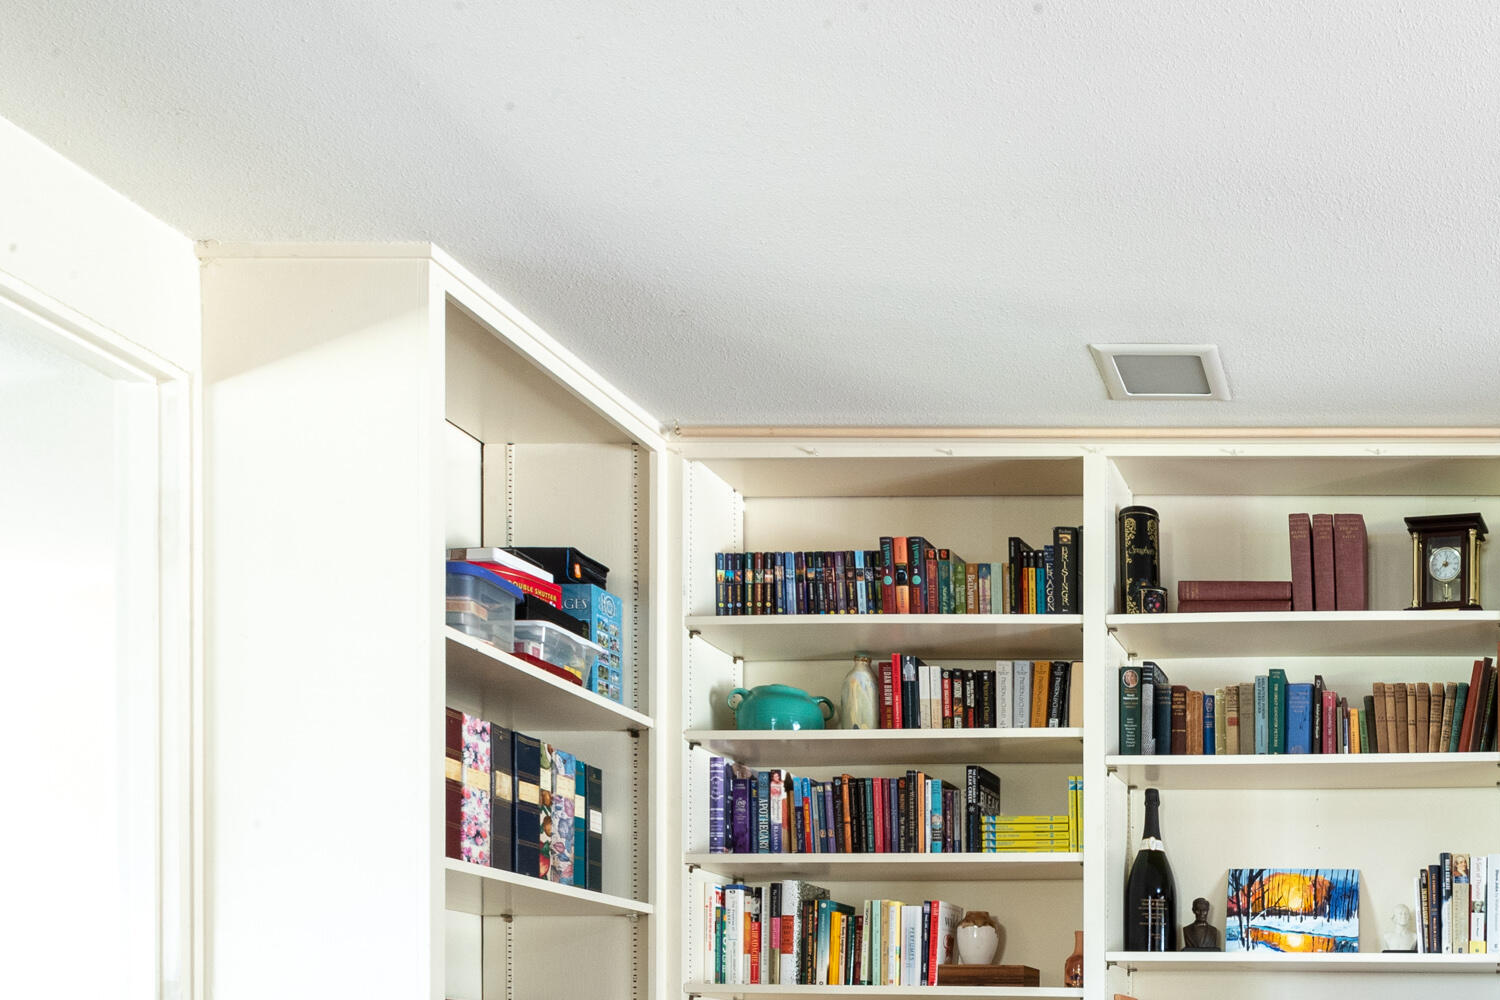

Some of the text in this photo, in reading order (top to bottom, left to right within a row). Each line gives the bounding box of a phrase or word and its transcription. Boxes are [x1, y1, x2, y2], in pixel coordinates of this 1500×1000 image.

[508, 580, 557, 602] OUBLE SHUTTER
[1045, 563, 1055, 612] ERAGON
[1060, 546, 1070, 606] BRISINGR
[883, 671, 892, 706] DAN BROWN
[759, 798, 769, 850] APOTHECARY
